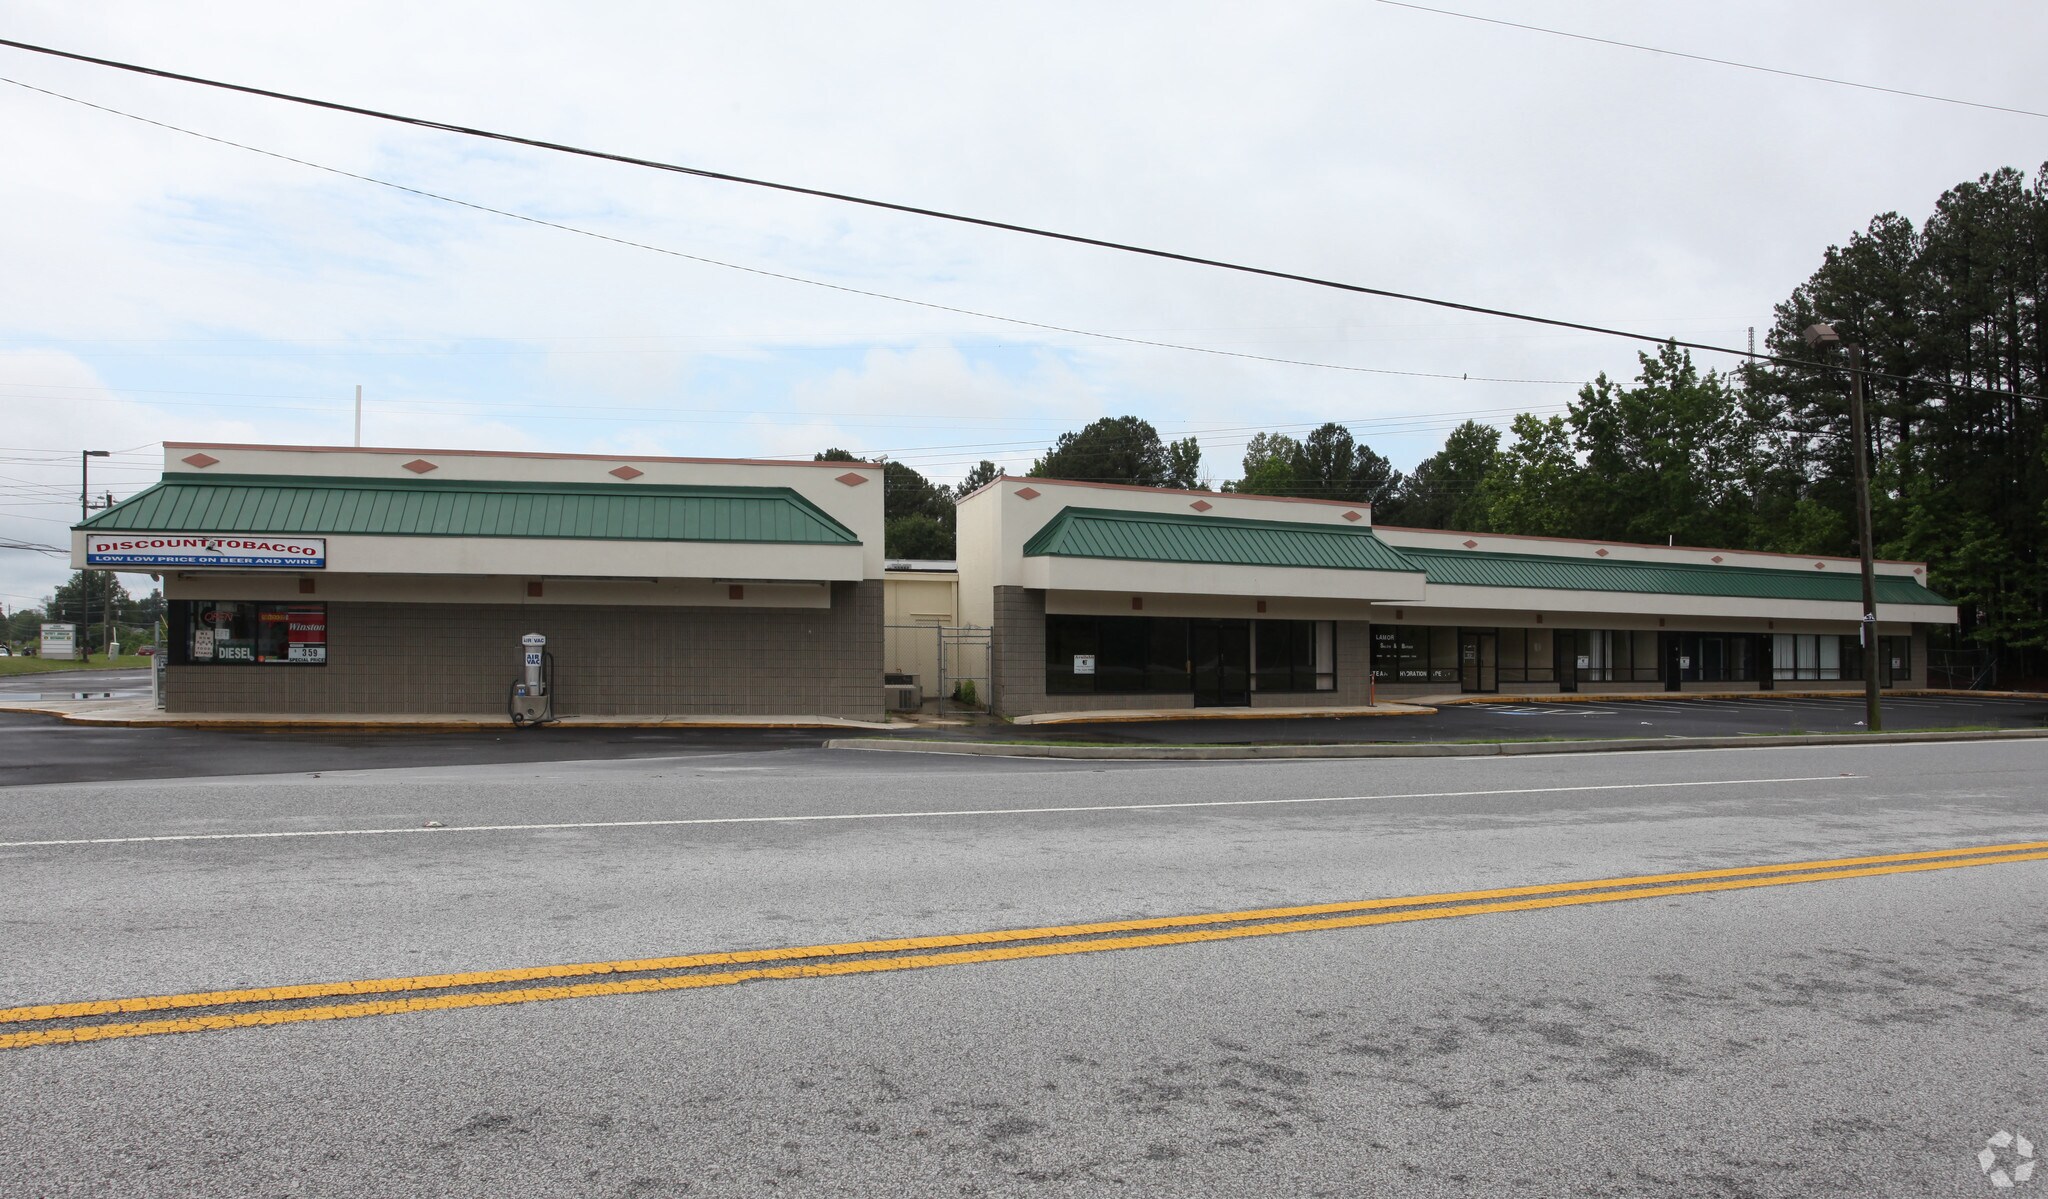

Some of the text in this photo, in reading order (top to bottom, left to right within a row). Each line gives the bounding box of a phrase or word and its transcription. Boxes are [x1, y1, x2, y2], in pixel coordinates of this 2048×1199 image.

[96, 539, 316, 556] DISCOUNT TOBACCO
[289, 623, 325, 631] Winston
[218, 647, 252, 659] DIESEL
